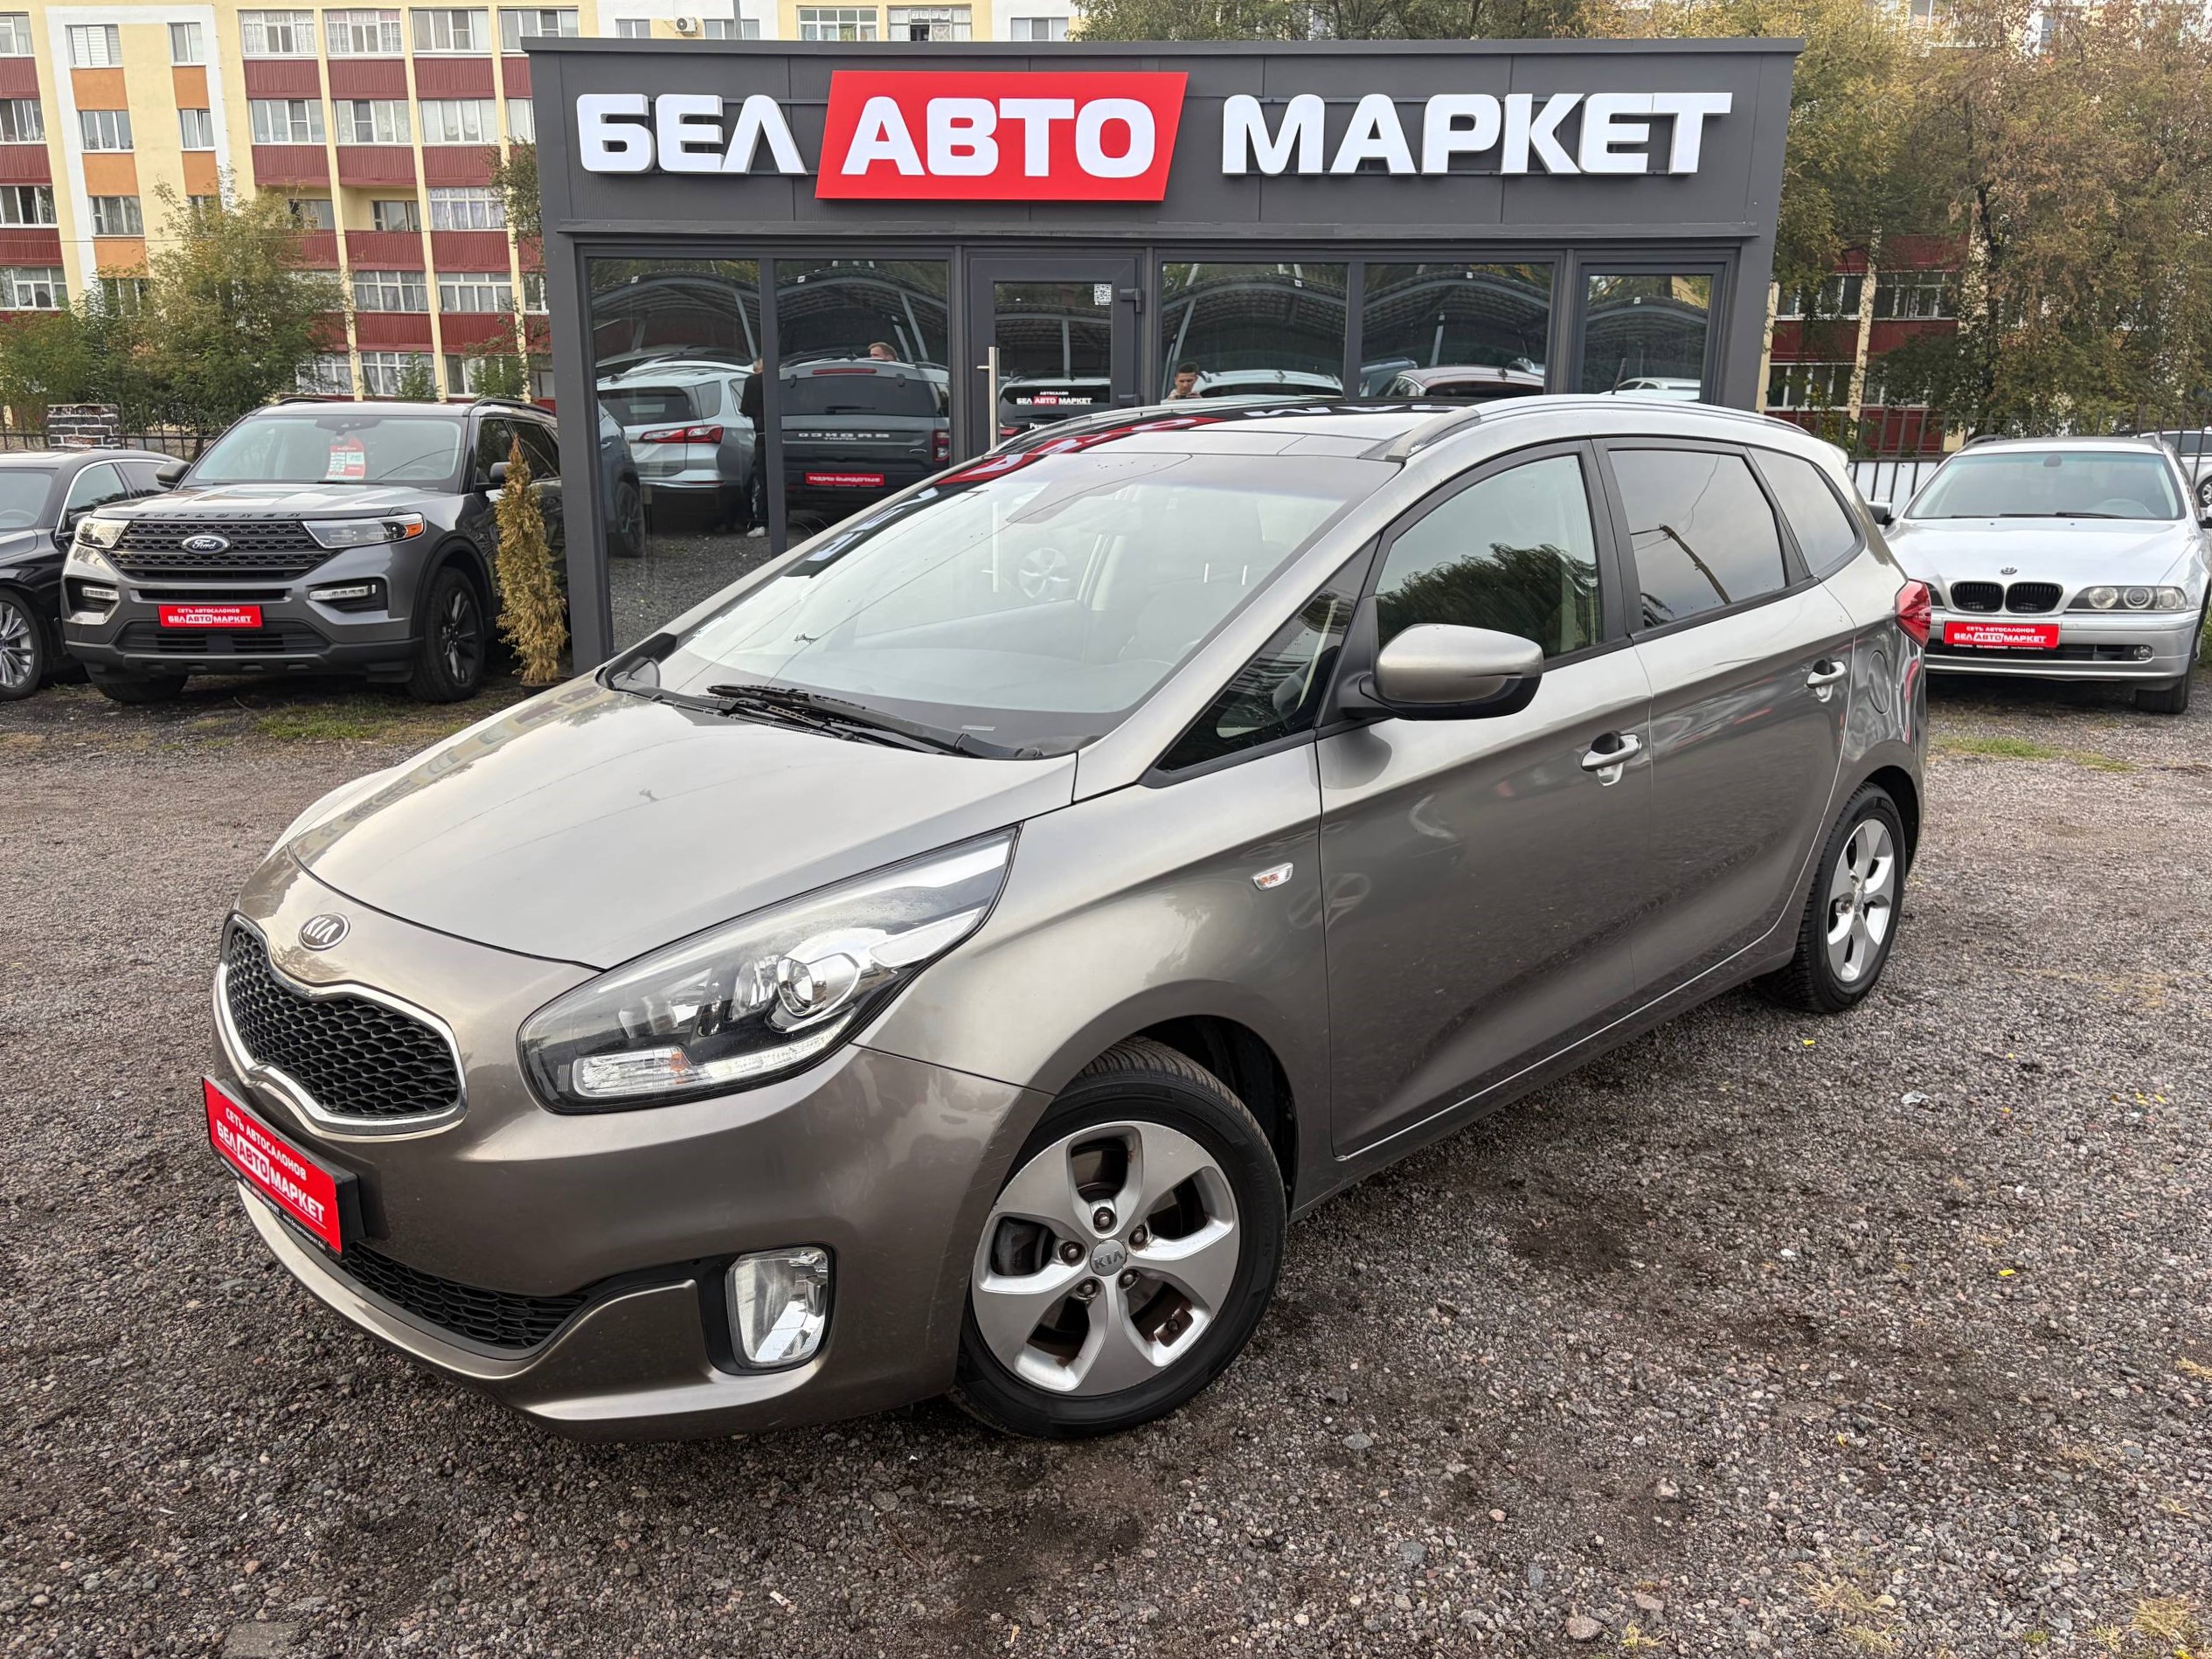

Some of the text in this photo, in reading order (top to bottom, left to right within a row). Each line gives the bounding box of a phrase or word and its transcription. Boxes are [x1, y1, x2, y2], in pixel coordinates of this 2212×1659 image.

[576, 92, 1733, 178] БЕЛ АВТО МАРКЕТ
[191, 539, 217, 550] Ford
[2004, 635, 2047, 643] МАРКЕТ
[302, 916, 340, 943] KIA
[225, 1107, 245, 1132] СЕТЬ
[246, 1124, 307, 1181] АВТОСАЛОНОВ
[217, 1119, 237, 1153] БЕЛ
[239, 1137, 268, 1177] АВТО
[270, 1167, 325, 1222] МАРКЕТ
[1093, 1250, 1123, 1269] KIA
